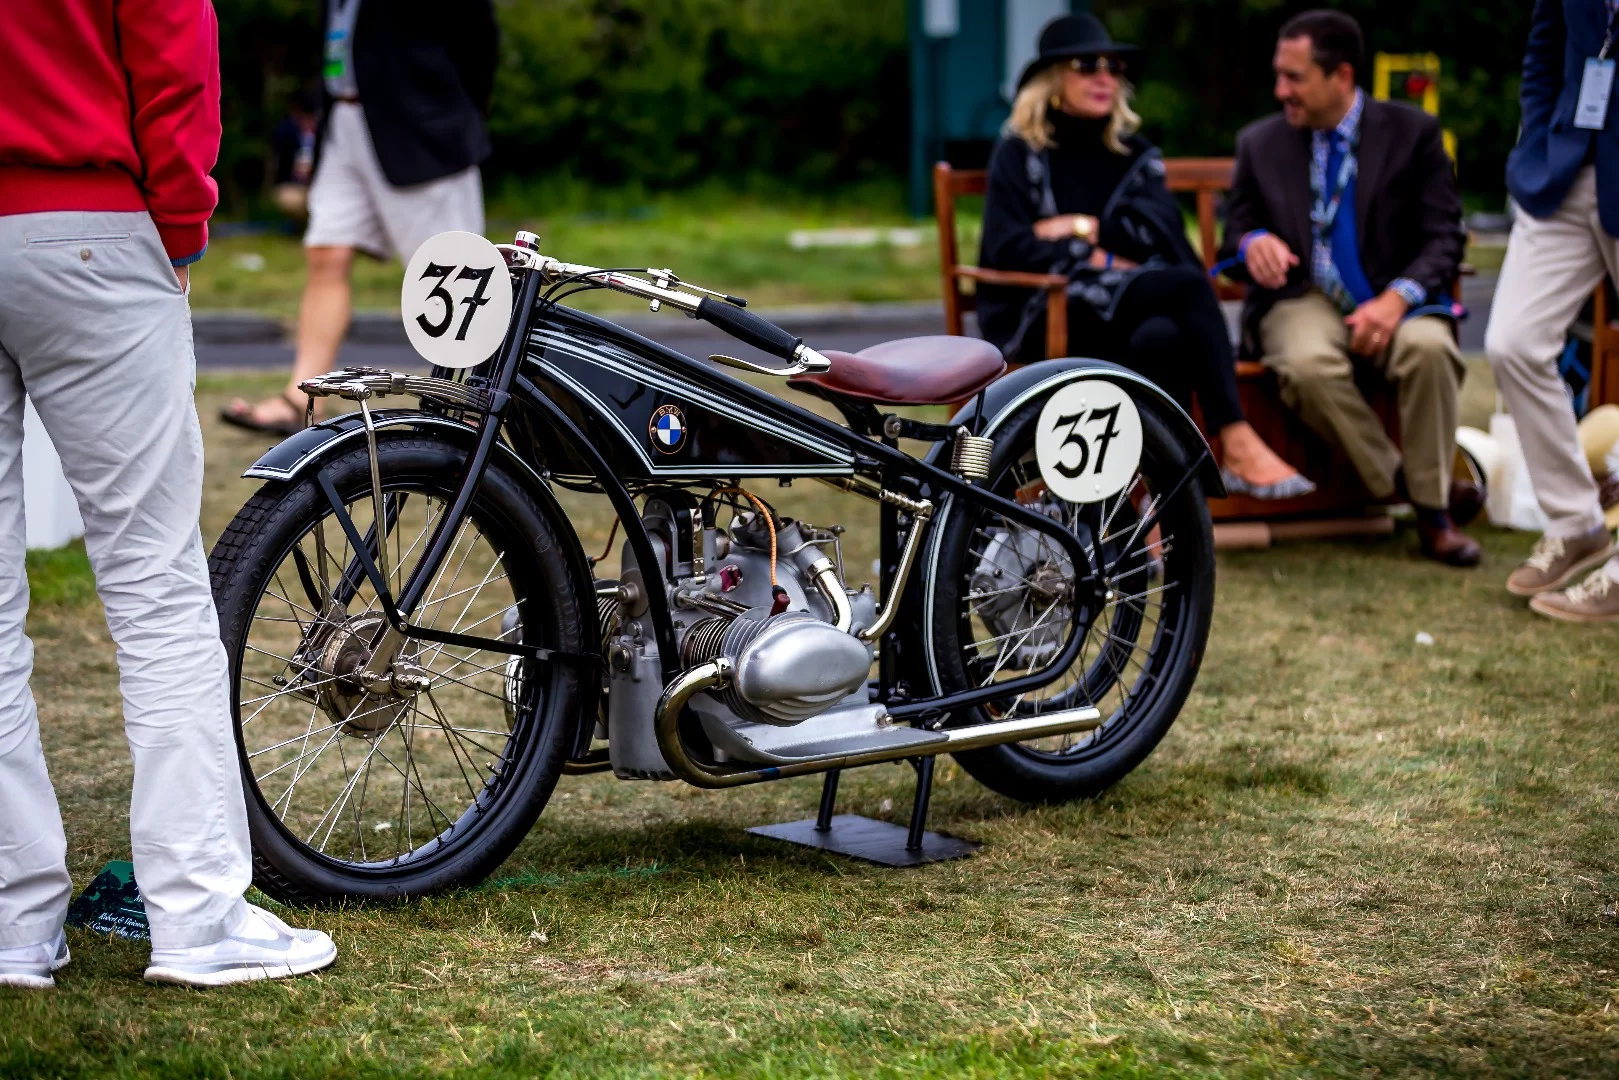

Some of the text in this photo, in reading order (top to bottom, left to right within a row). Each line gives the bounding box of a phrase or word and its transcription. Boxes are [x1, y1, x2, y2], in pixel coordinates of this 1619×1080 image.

[415, 261, 496, 341] 37
[658, 406, 681, 417] BMW
[1051, 402, 1122, 479] 37
